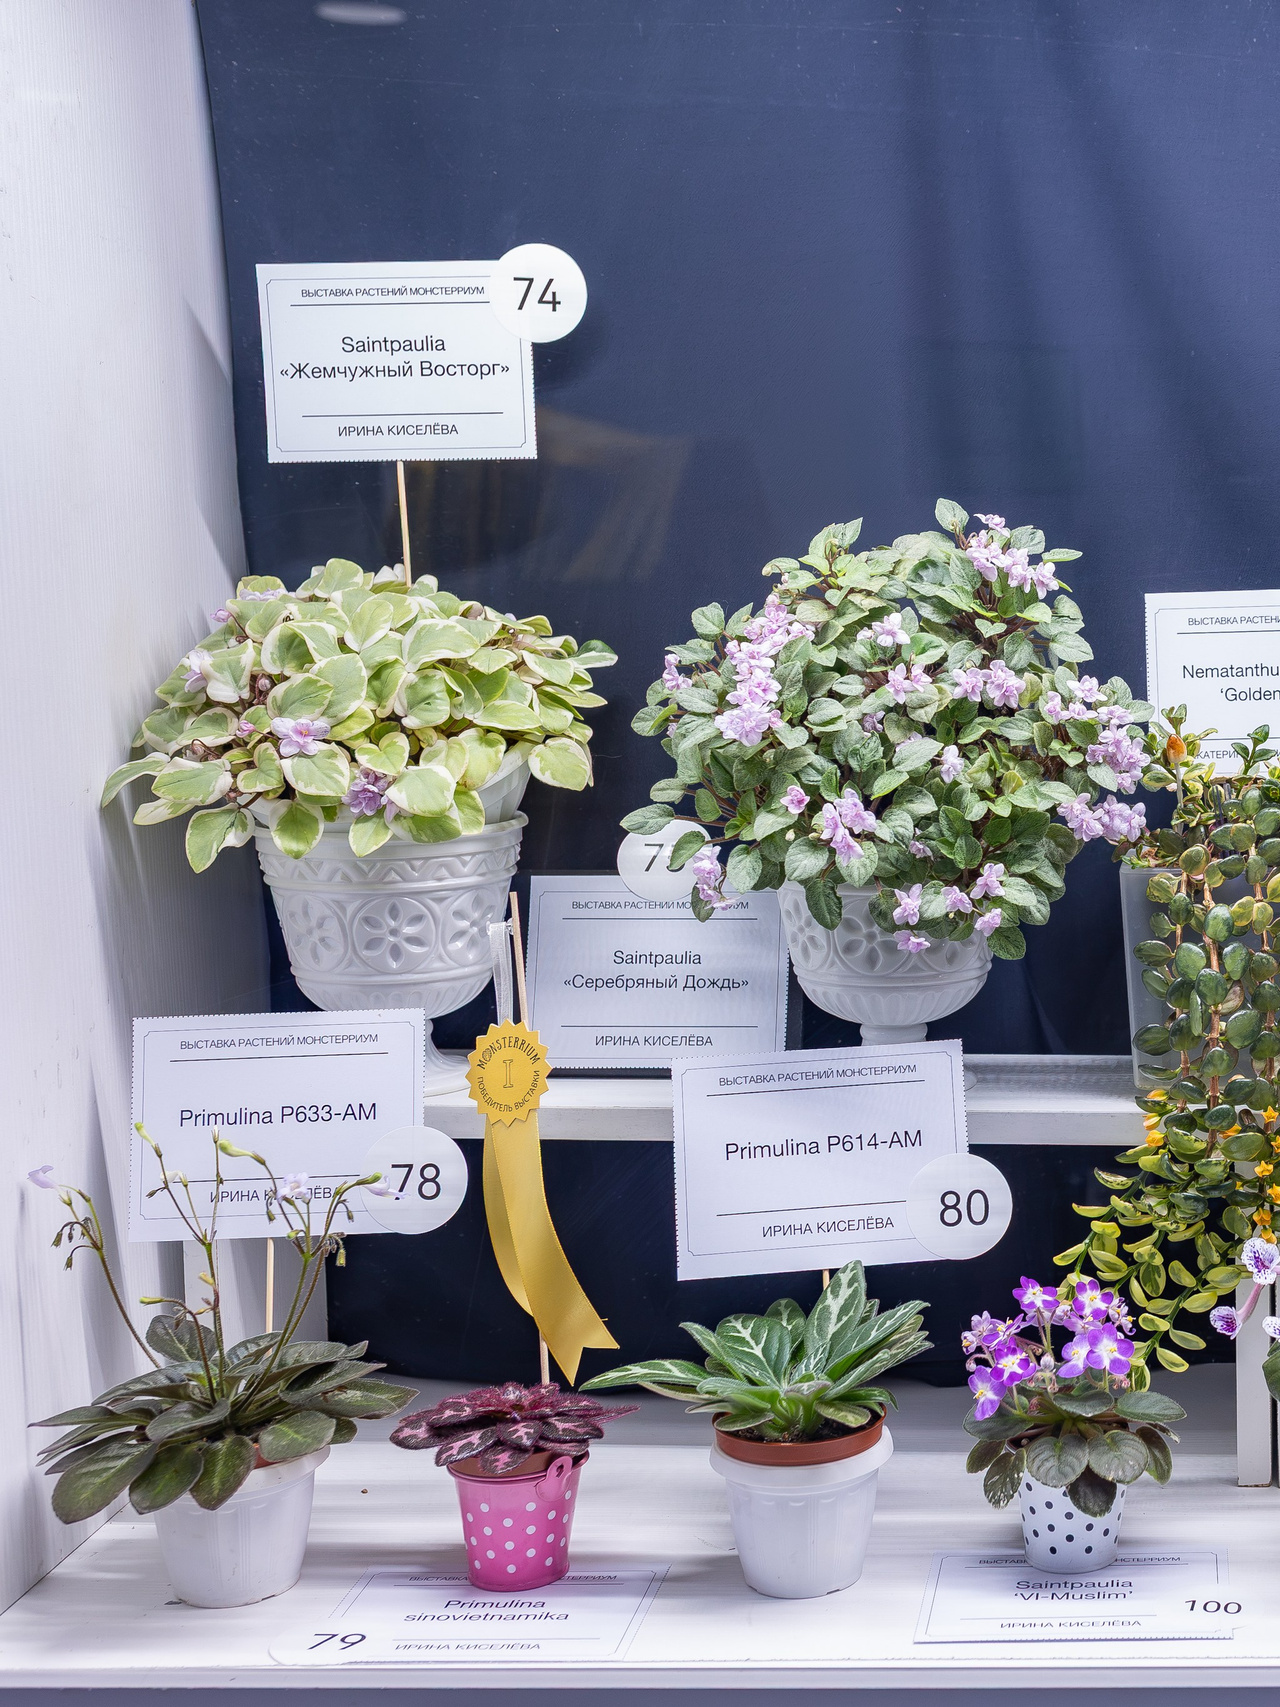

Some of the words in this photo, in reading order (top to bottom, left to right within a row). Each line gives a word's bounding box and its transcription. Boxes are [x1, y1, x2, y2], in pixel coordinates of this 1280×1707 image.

[301, 288, 354, 298] ВЫСТАВКА
[355, 285, 408, 297] РАСТЕНИЙ
[409, 286, 485, 297] МОНСТЕРРИУМ
[513, 277, 561, 312] 74
[341, 335, 446, 355] Saintpaulia
[280, 360, 413, 382] «Жемчужный
[420, 359, 510, 379] Восторг»
[338, 425, 384, 437] ИРИНА
[388, 422, 459, 436] КИСЕЛЁВА
[1187, 616, 1238, 626] ВЫСТАВКА
[572, 901, 622, 910] ВЫСТАВКА
[613, 950, 702, 967] Saintpaulia
[563, 975, 678, 991] «Серебряный
[683, 975, 749, 991] Дождь»
[180, 1039, 236, 1050] ВЫСТАВКА
[238, 1036, 295, 1047] РАСТЕНИЙ
[297, 1034, 378, 1045] МОНСТЕРРИУМ
[595, 1036, 640, 1046] ИРИНА
[643, 1034, 713, 1047] КИСЕЛЁВА
[719, 1074, 776, 1087] ВЫСТАВКА
[777, 1069, 834, 1082] РАСТЕНИЙ
[836, 1064, 917, 1078] МОНСТЕРРИУМ
[477, 1076, 513, 1112] ПОБЕДИТЕЛЬ
[514, 1070, 540, 1110] ВЫСТАВКИ
[179, 1107, 273, 1127] Primulina
[281, 1102, 377, 1124] P633-AM
[725, 1138, 820, 1160] Primulina
[827, 1129, 923, 1153] P614-AM
[390, 1162, 441, 1201] 78
[210, 1189, 260, 1203] ИРИНА
[939, 1189, 990, 1228] 80
[762, 1223, 813, 1238] ИРИНА
[817, 1216, 894, 1234] КИСЕЛЁВА
[1016, 1579, 1133, 1590] Saintpaulia
[444, 1600, 546, 1609] Primulina
[1184, 1600, 1243, 1614] 100
[404, 1612, 569, 1622] sinovietnamika
[1058, 1620, 1142, 1628] КИСЕЛЁВА
[307, 1634, 367, 1650] 79
[395, 1643, 450, 1651] ИРИНА
[455, 1642, 541, 1650] КИСЕЛЁВА
